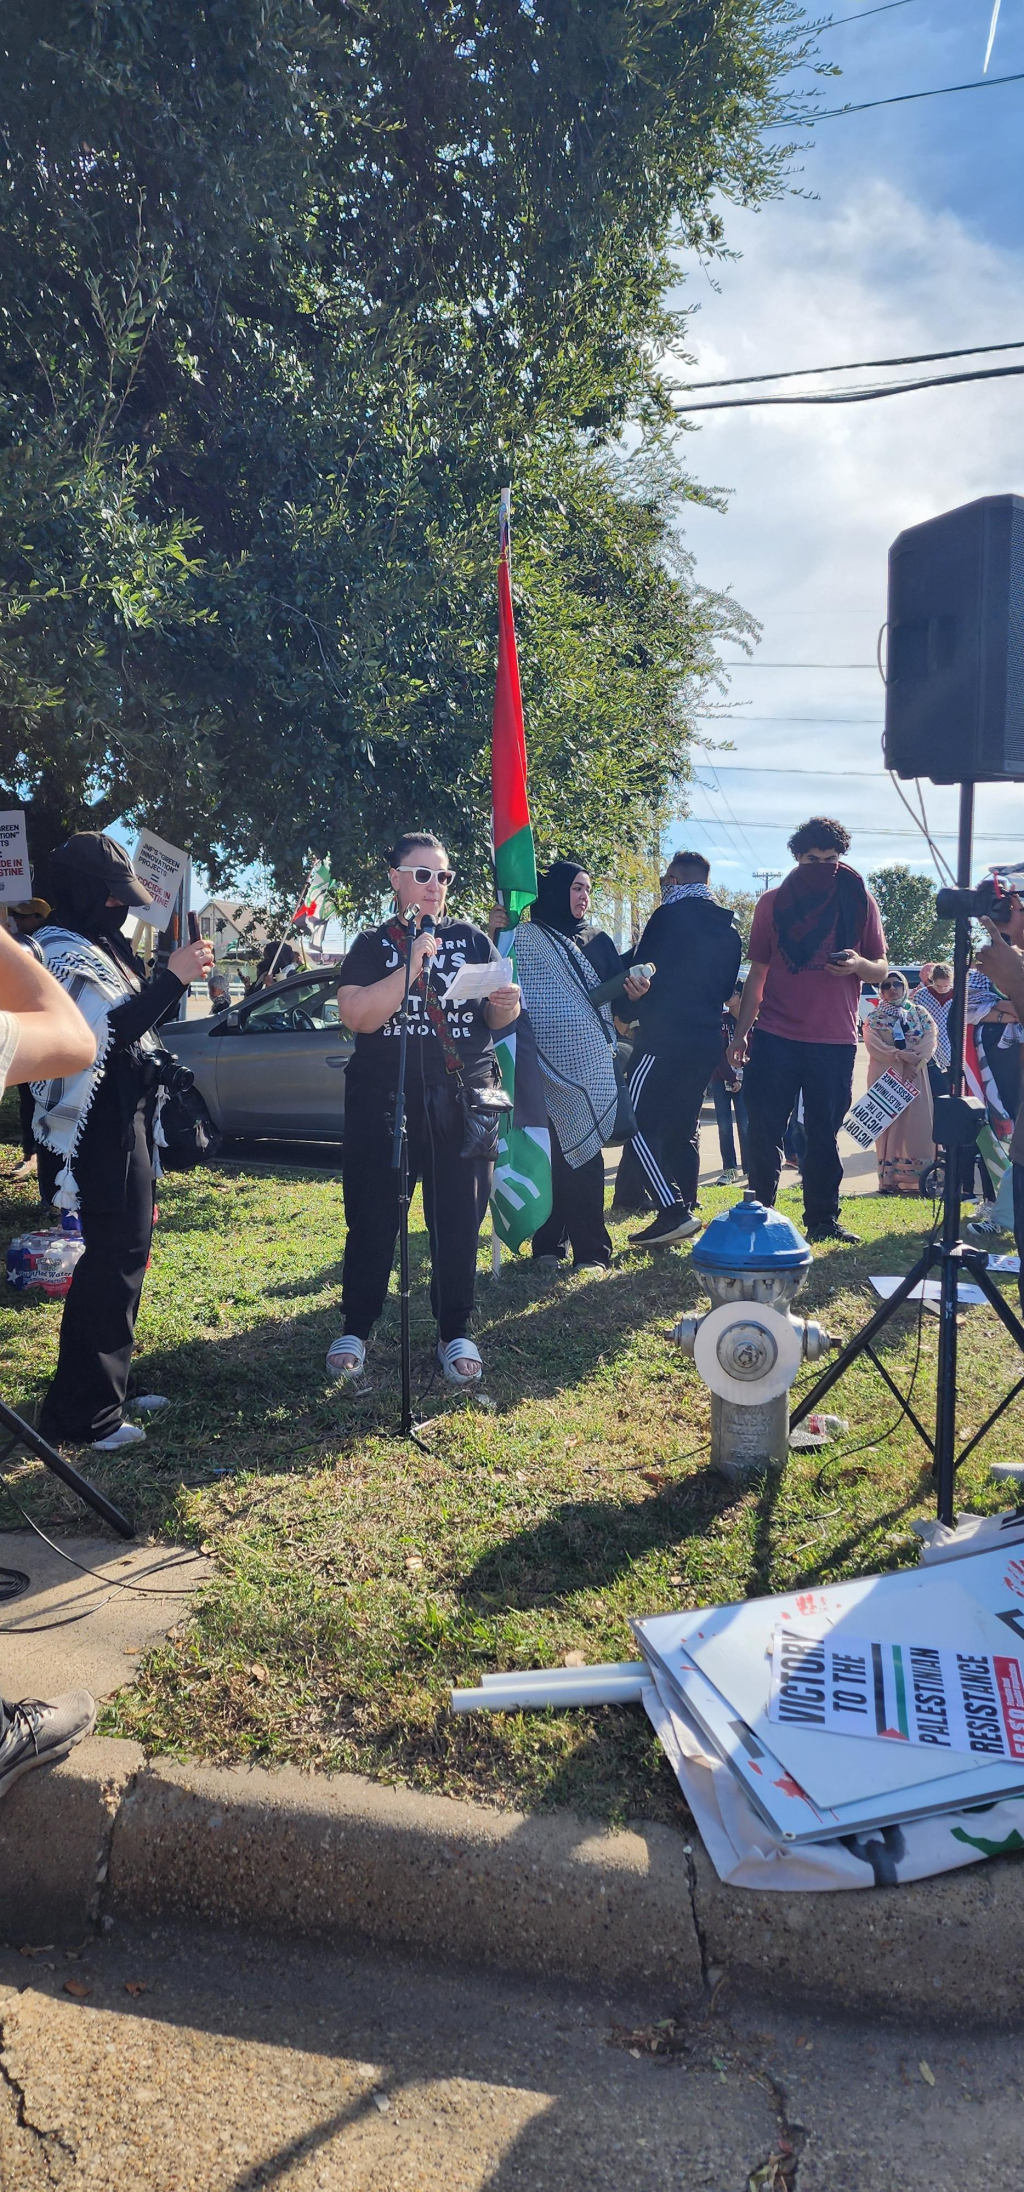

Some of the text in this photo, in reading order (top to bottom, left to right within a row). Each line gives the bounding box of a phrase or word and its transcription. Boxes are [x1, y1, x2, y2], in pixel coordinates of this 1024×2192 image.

[14, 859, 23, 867] IN
[138, 856, 167, 876] PROJECTS
[140, 849, 178, 873] INNOVATION"
[137, 876, 171, 899] COCIDE IN
[385, 951, 466, 969] JWS
[383, 1024, 471, 1038] GENODE
[873, 1082, 904, 1111] PALESTINIAN
[881, 1073, 913, 1102] RESISTANCE
[851, 1105, 883, 1135] VICTORY
[865, 1101, 885, 1121] TO THE
[843, 1119, 873, 1148] VICTORY
[778, 1629, 826, 1724] VICTORY
[832, 1652, 868, 1714] TO THE
[910, 1647, 951, 1747] PALESTINIAN
[957, 1654, 1005, 1755] RESISTANCE
